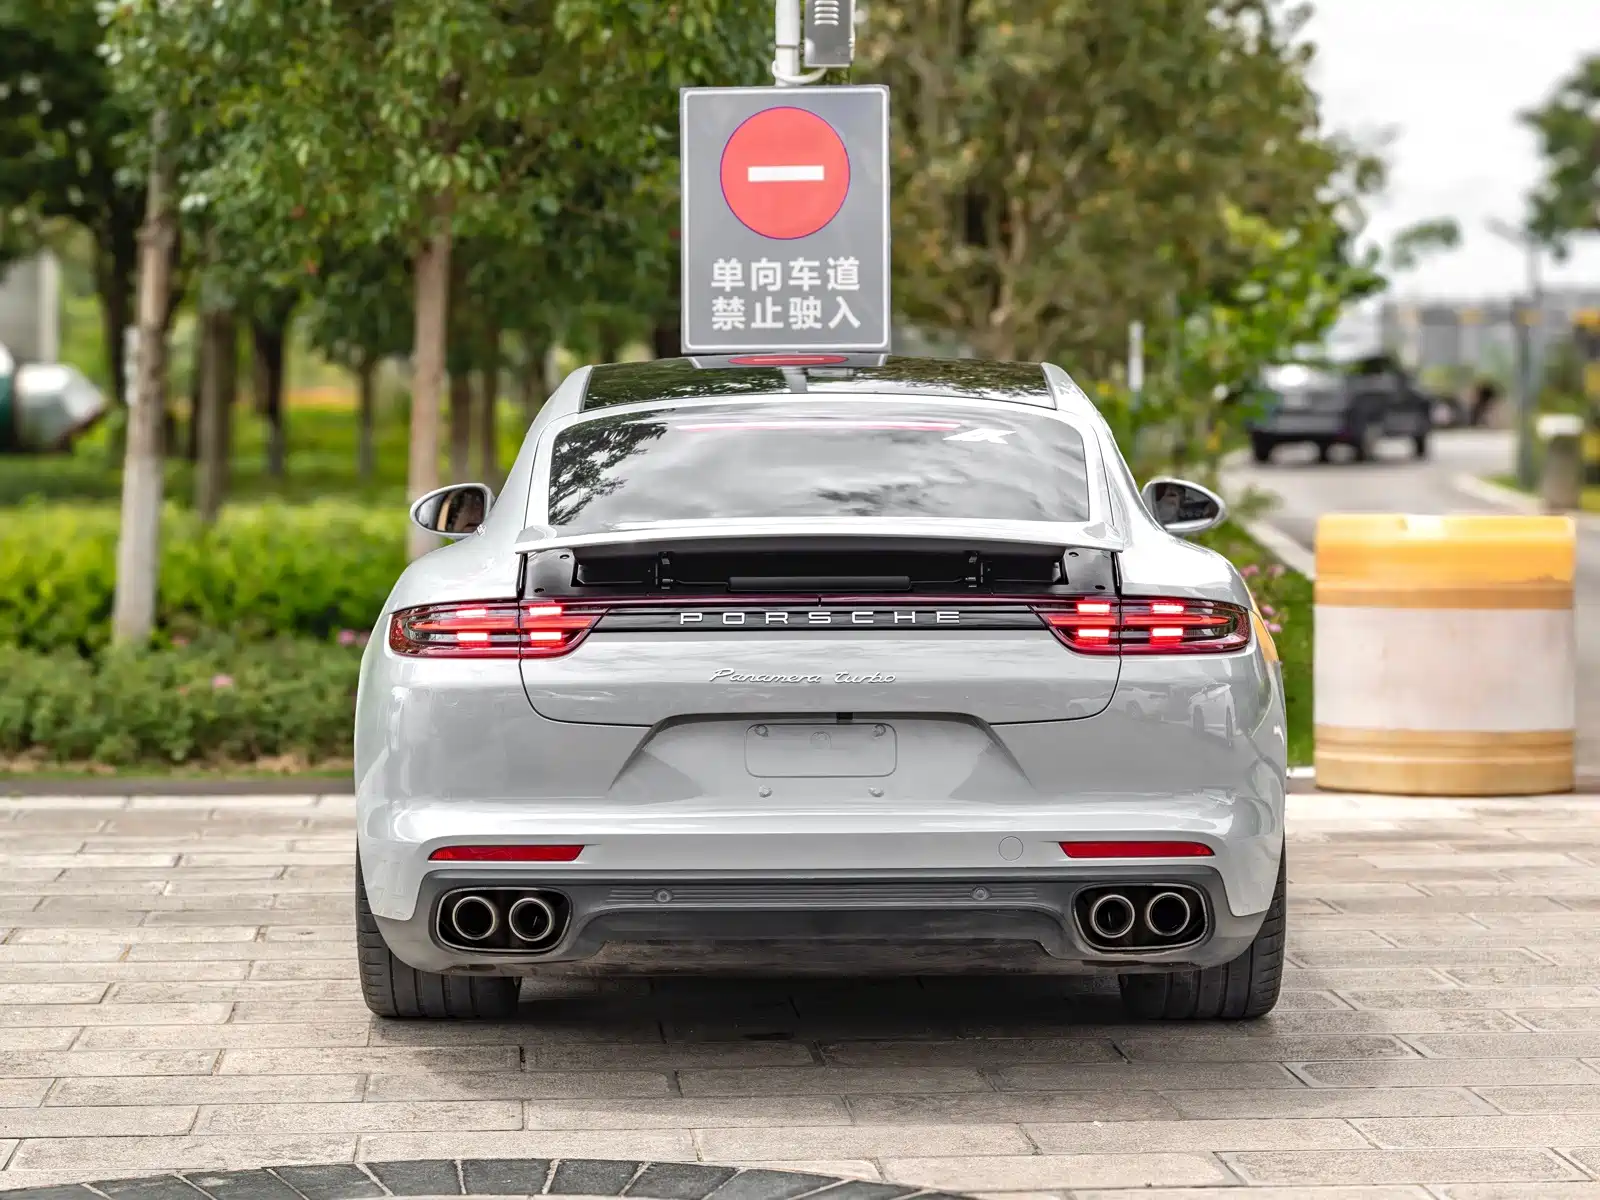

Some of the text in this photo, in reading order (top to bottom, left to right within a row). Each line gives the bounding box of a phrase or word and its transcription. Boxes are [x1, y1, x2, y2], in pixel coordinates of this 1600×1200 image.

[711, 256, 860, 292] 单向车道
[711, 296, 861, 330] 禁止驶入
[680, 611, 960, 625] PORSCHE
[709, 667, 821, 683] Panamera
